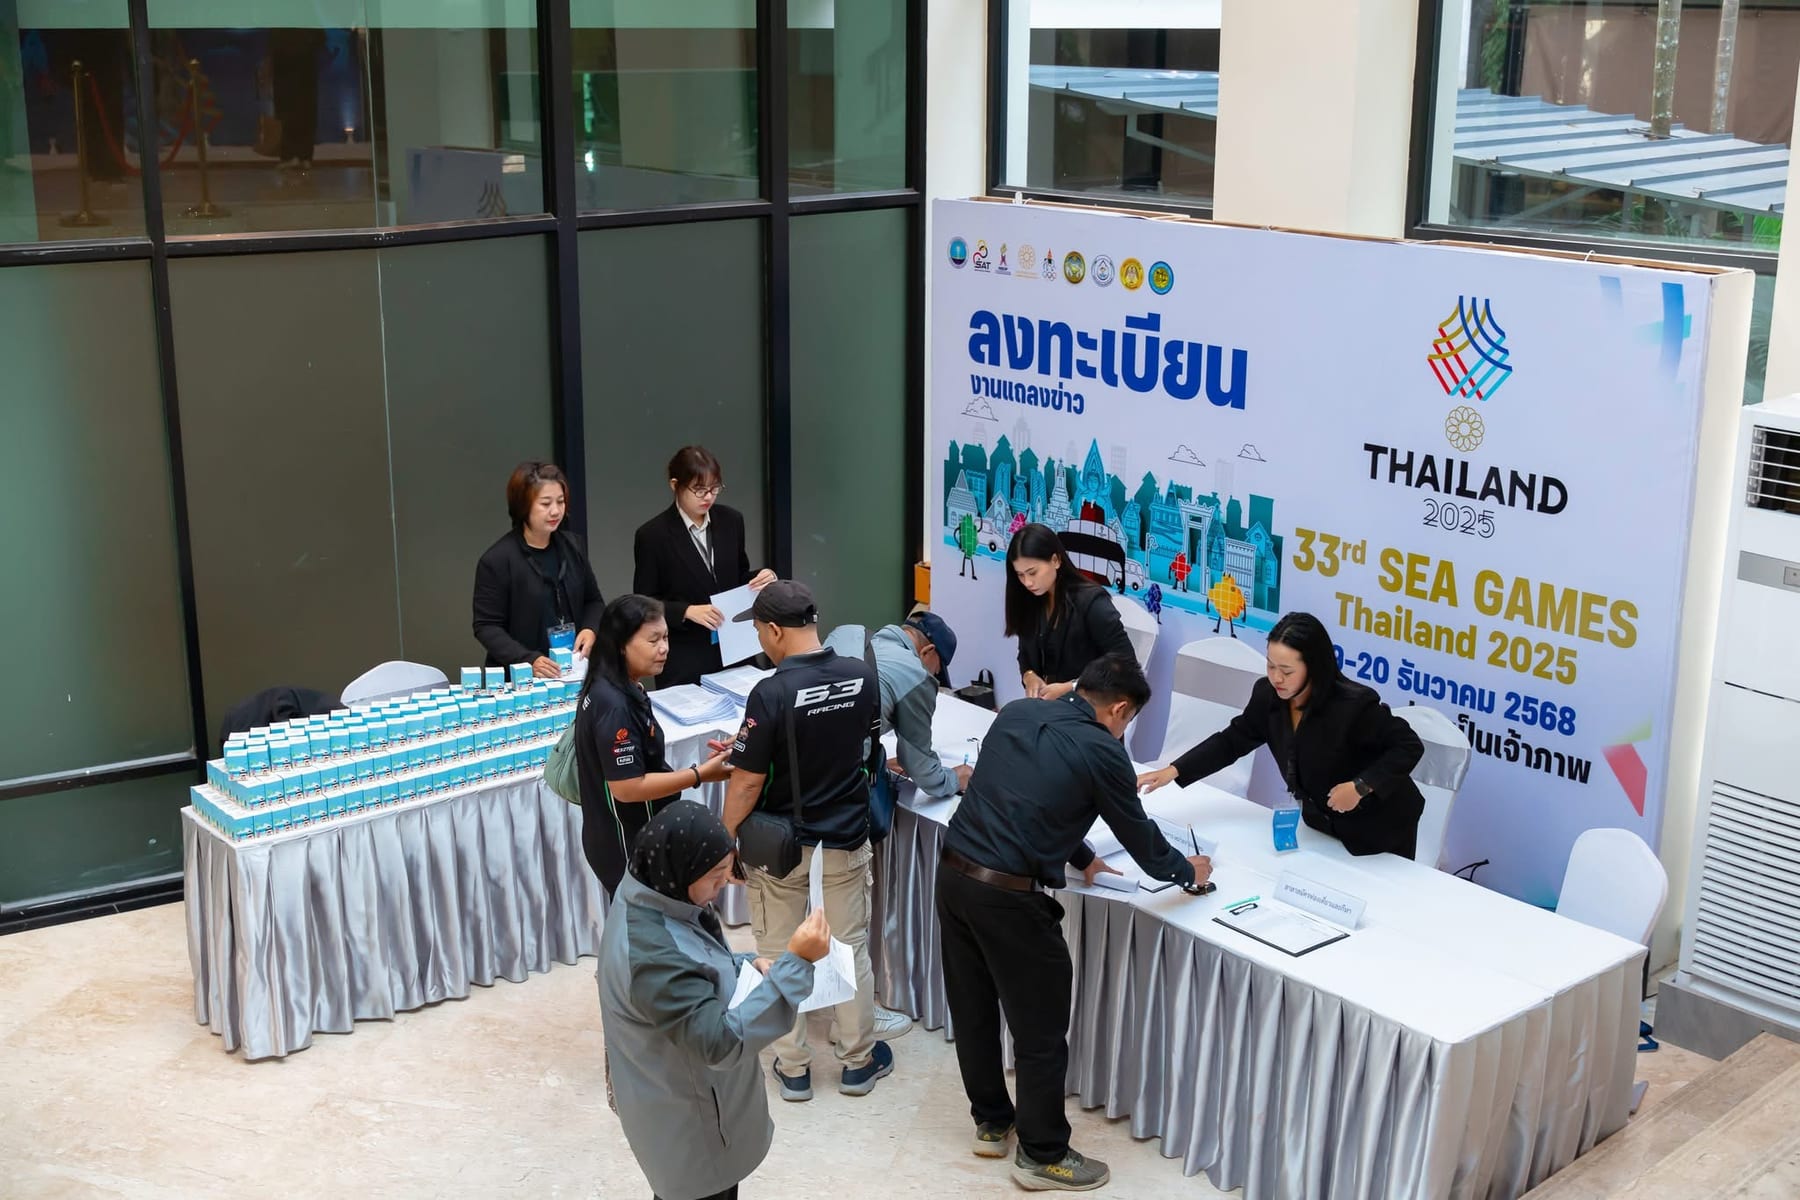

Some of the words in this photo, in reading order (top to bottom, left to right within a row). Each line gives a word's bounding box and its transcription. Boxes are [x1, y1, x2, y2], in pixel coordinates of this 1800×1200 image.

[968, 310, 1248, 410] ลงทะเบียน
[971, 374, 1085, 415] งานแถลงข่าว
[1364, 443, 1568, 515] THAILAND
[1423, 498, 1495, 538] 2025
[1293, 527, 1367, 577] 33rd
[1378, 547, 1458, 608] SEA
[1474, 569, 1640, 649] GAMES
[1335, 592, 1477, 660] Thailand
[1486, 631, 1578, 686] 2025
[807, 701, 855, 716] RACING
[1397, 658, 1496, 714] ธันวาคม
[1504, 691, 1576, 737] 2568
[1454, 713, 1592, 784] ป็นเจ้าภาพ
[1046, 1165, 1073, 1178] HOKA
